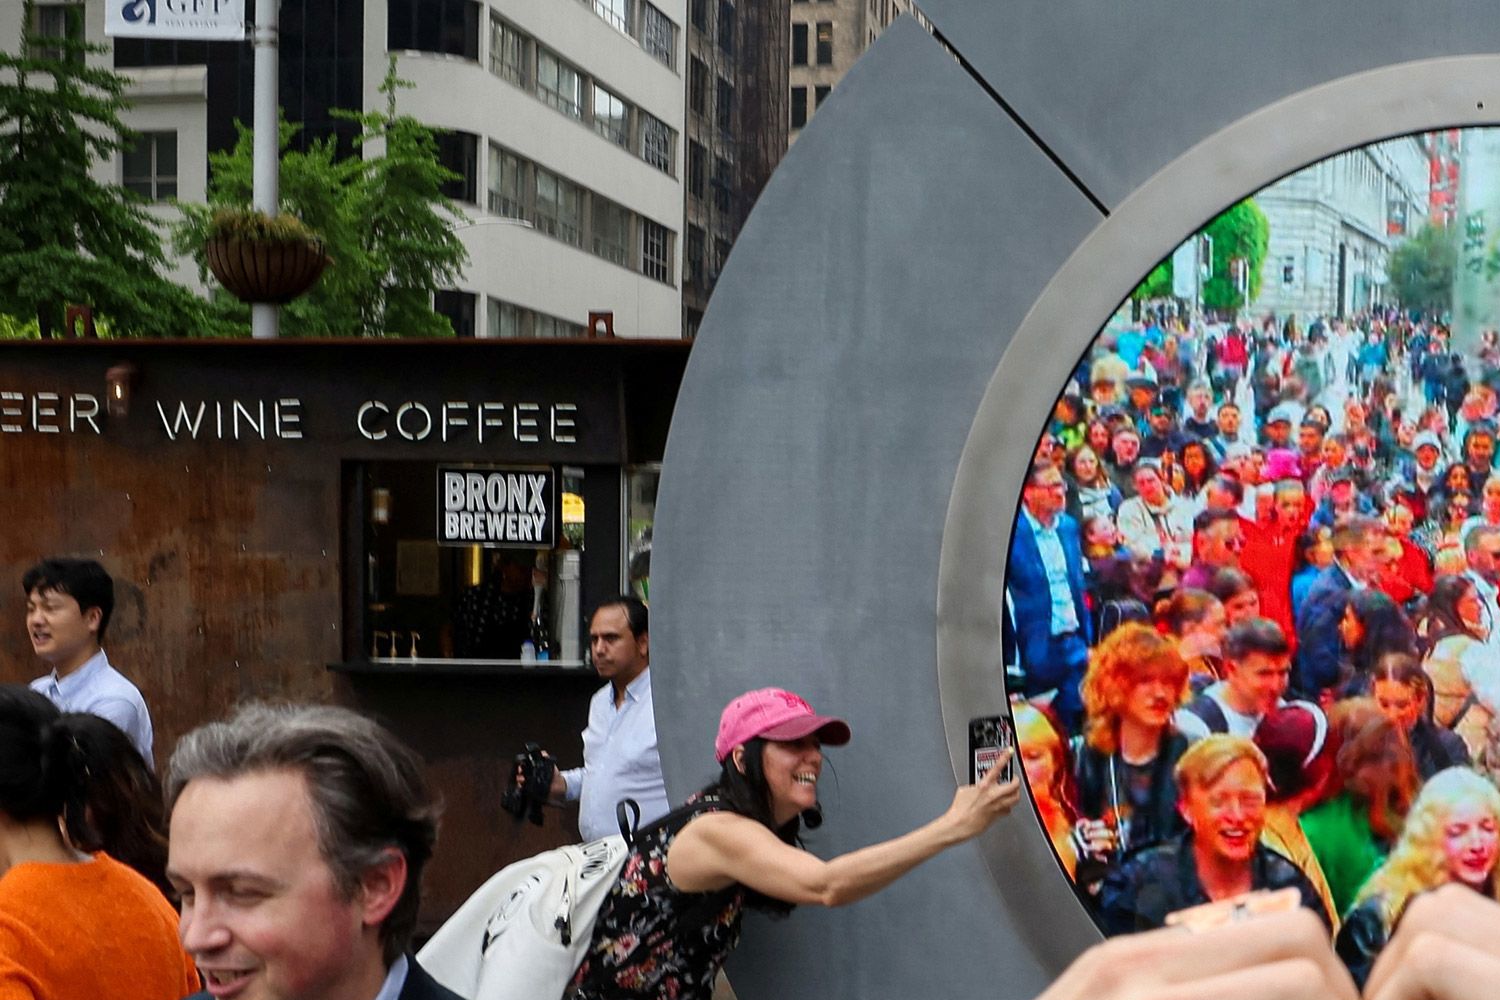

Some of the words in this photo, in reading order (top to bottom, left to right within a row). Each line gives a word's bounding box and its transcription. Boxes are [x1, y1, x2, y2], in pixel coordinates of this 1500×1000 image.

[156, 398, 302, 440] WINE
[357, 400, 577, 443] COFFEE
[445, 472, 546, 513] BRONX
[445, 511, 546, 541] BREWERY
